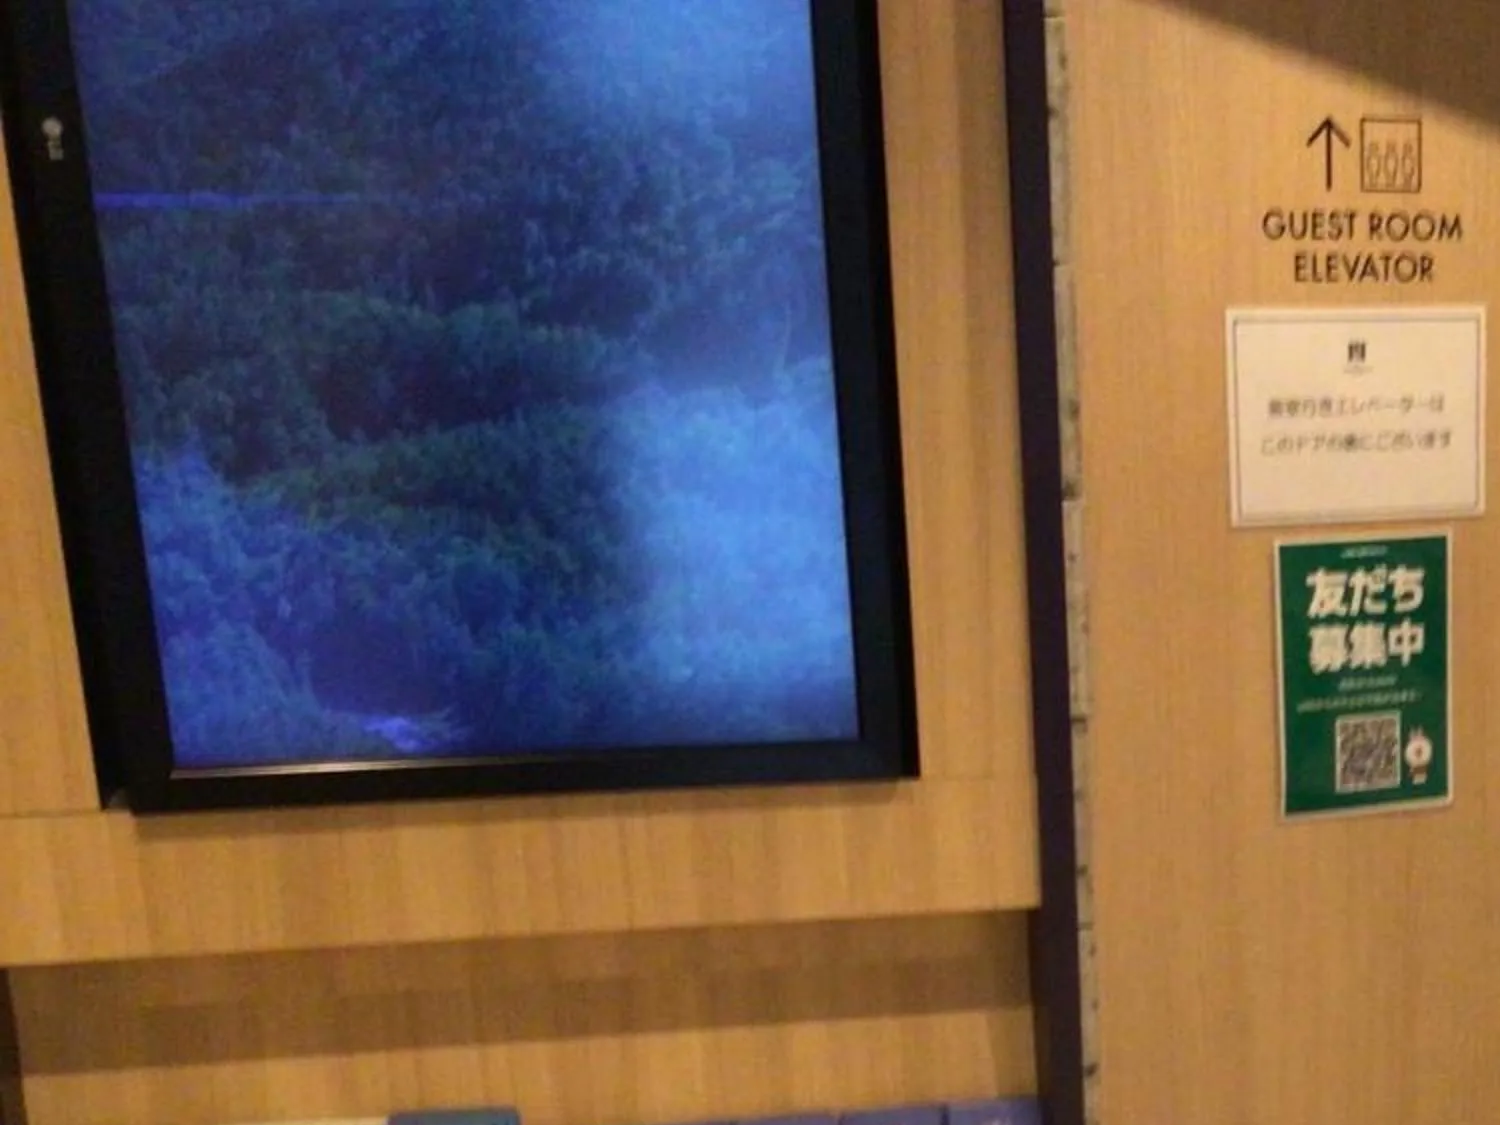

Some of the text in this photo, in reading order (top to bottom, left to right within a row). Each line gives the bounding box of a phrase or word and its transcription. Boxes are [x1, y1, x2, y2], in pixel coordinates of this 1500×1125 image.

[1262, 208, 1463, 242] GUEST ROOM
[1293, 254, 1435, 283] ELEVATOR
[1306, 563, 1425, 617] 友だち
[1309, 617, 1425, 675] 募集中
